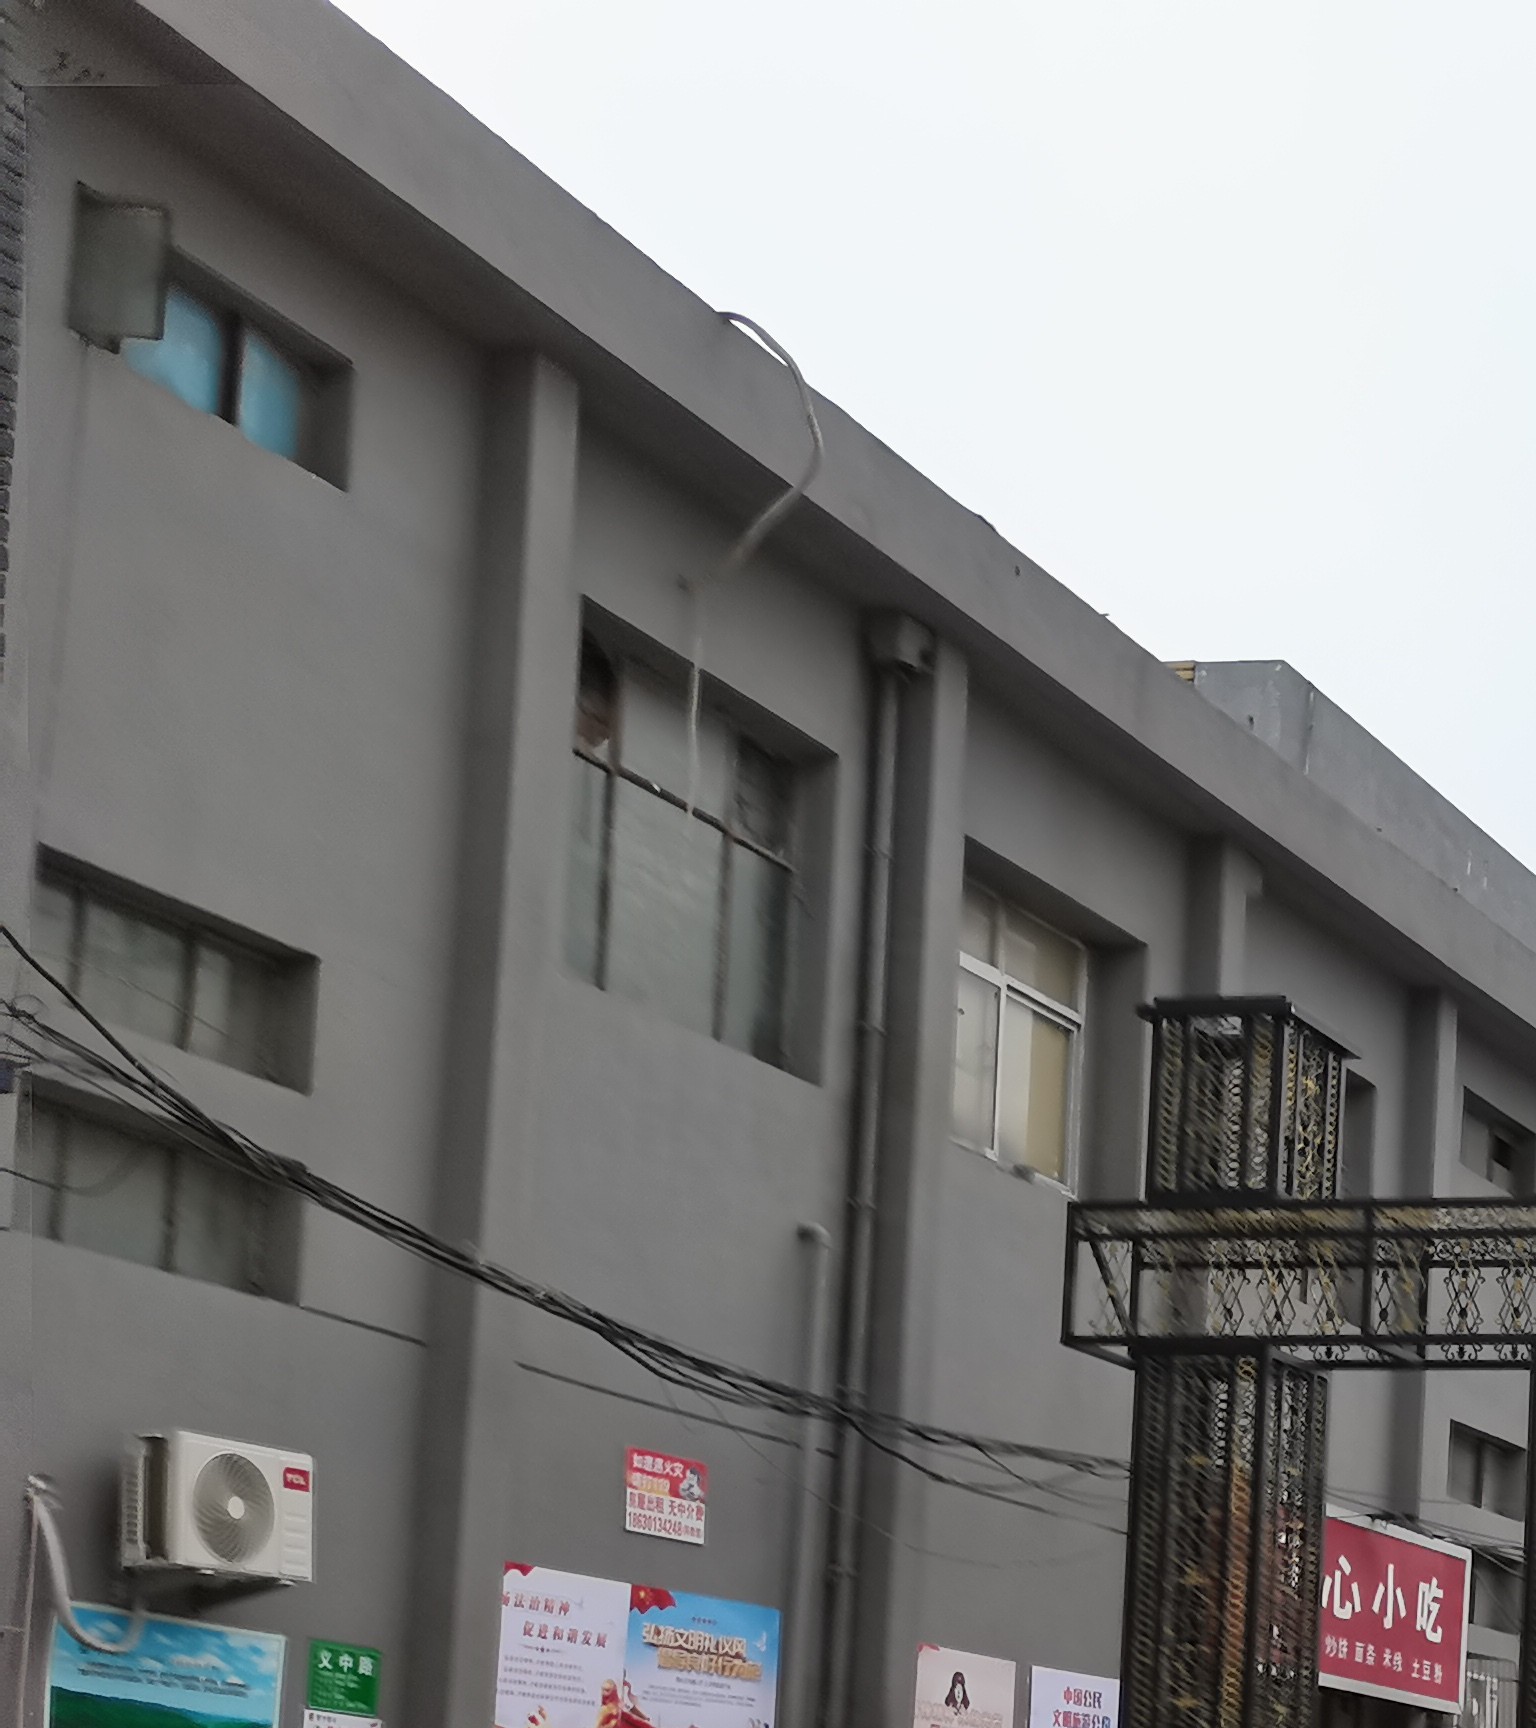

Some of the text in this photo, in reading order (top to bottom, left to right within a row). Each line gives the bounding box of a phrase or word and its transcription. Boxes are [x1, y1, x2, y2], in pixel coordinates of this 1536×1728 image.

[1321, 1554, 1444, 1644] 心小吃
[522, 1620, 608, 1648] 促进和谐发展
[318, 1649, 374, 1677] 义中路
[1354, 1641, 1376, 1665] 面条
[1063, 1686, 1102, 1710] 中国公民
